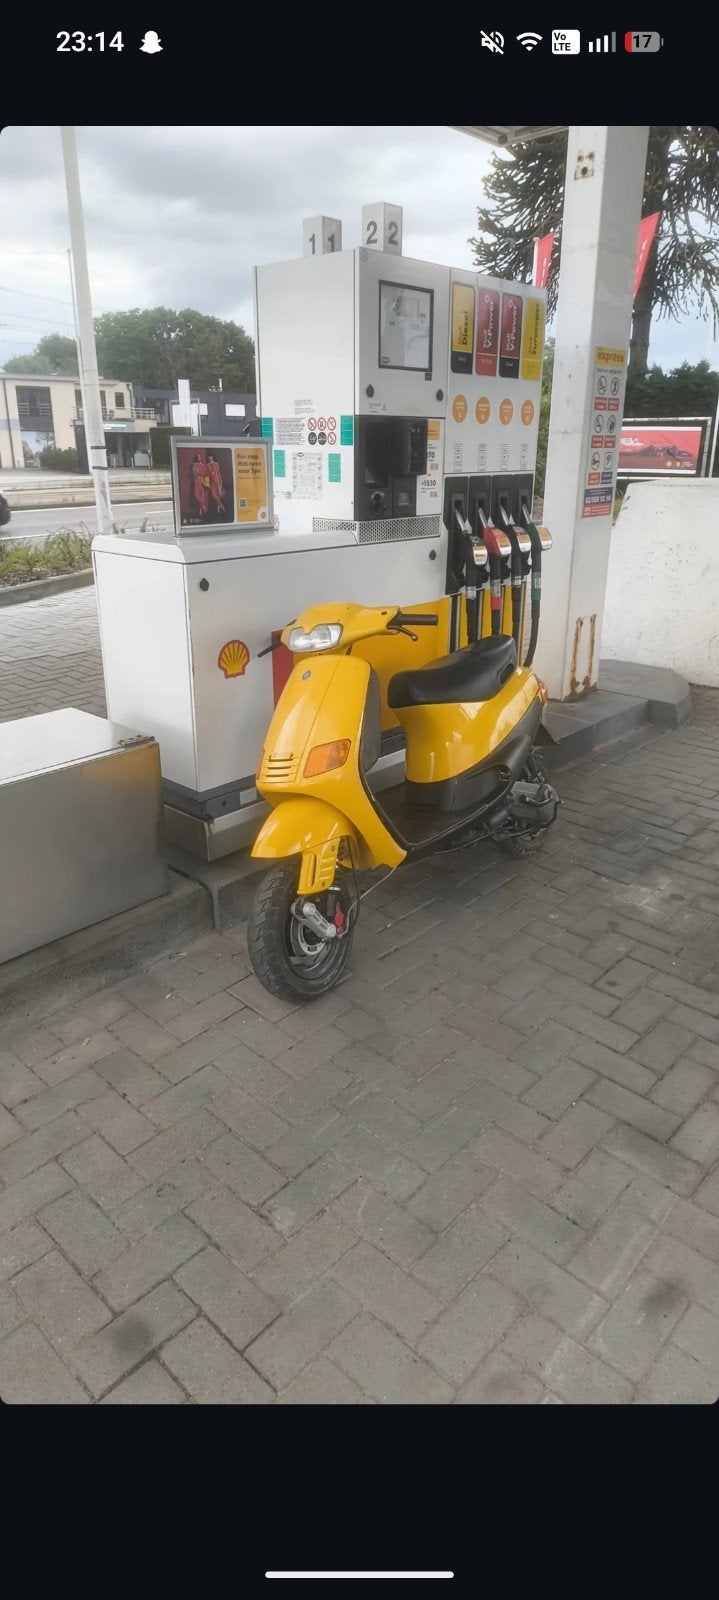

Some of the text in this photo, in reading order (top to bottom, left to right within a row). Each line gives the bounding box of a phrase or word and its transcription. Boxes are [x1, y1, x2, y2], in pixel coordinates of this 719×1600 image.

[308, 233, 316, 255] 1
[327, 233, 335, 252] 1
[366, 221, 378, 245] 2
[388, 221, 399, 246] 2
[486, 299, 494, 348] V-Power
[509, 303, 518, 352] V-Power
[597, 351, 625, 363] express
